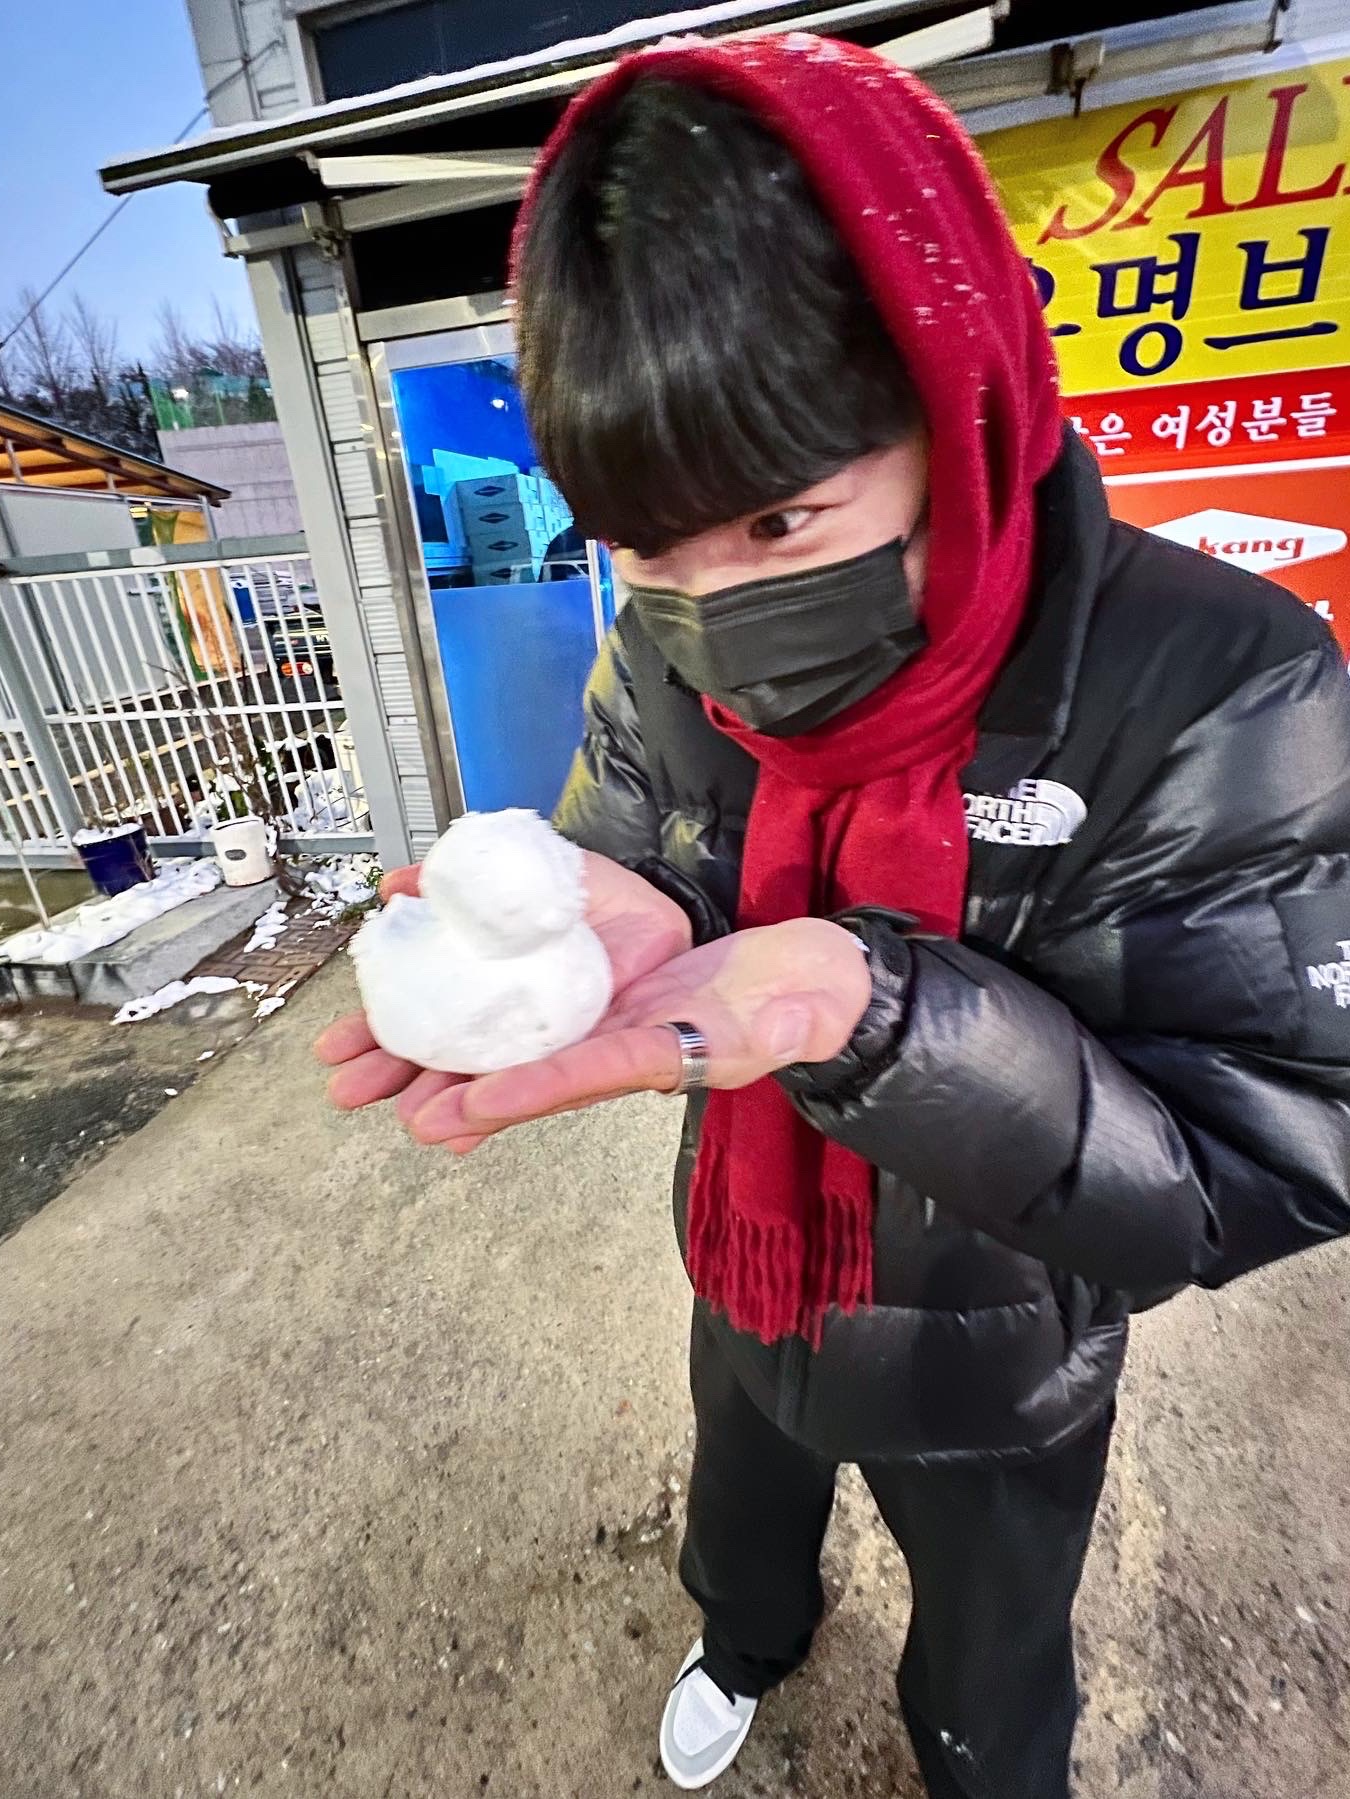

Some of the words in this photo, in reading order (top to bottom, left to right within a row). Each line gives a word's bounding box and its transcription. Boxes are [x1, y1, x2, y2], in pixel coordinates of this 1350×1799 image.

[1036, 75, 1350, 245] SAL
[1024, 226, 1340, 377] 명브
[1151, 391, 1338, 450] 여성분들
[962, 792, 1034, 824] ORTH
